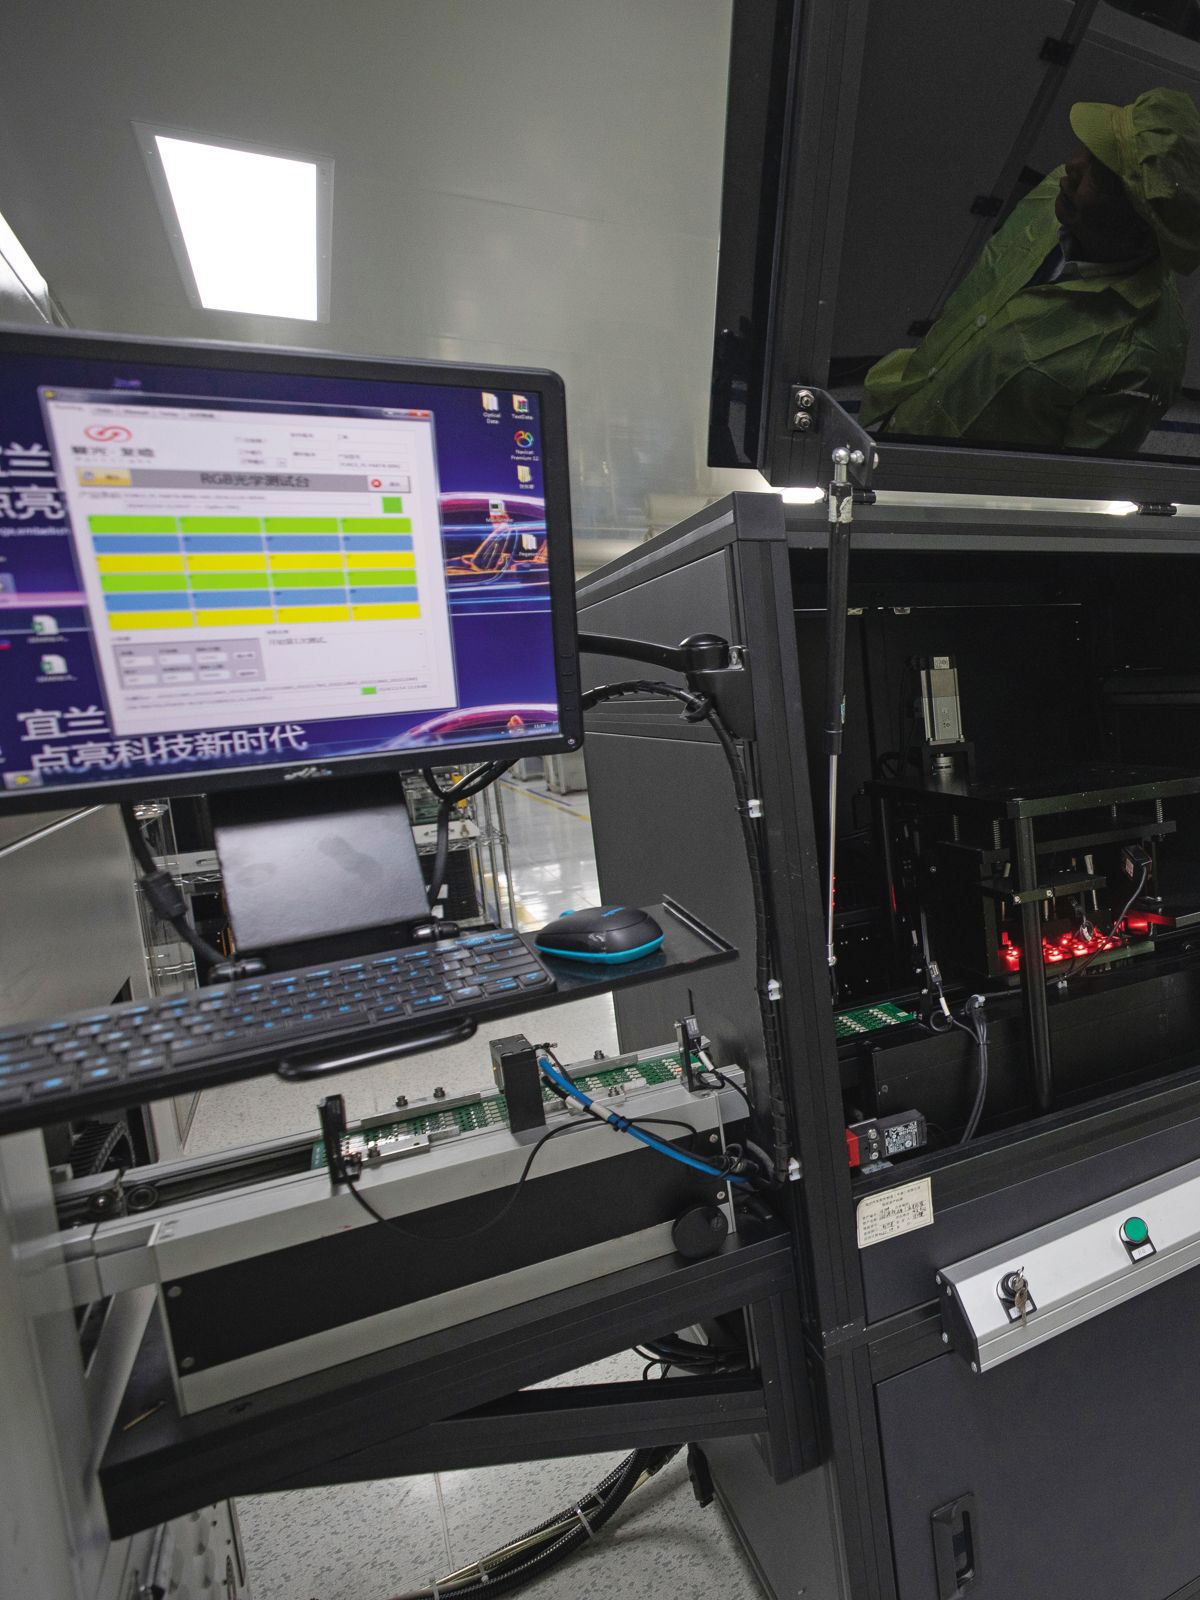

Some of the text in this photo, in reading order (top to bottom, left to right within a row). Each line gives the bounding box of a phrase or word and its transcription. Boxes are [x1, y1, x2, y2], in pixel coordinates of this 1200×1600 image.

[17, 704, 111, 741] 宜兰
[31, 723, 309, 775] 点亮科技新时代
